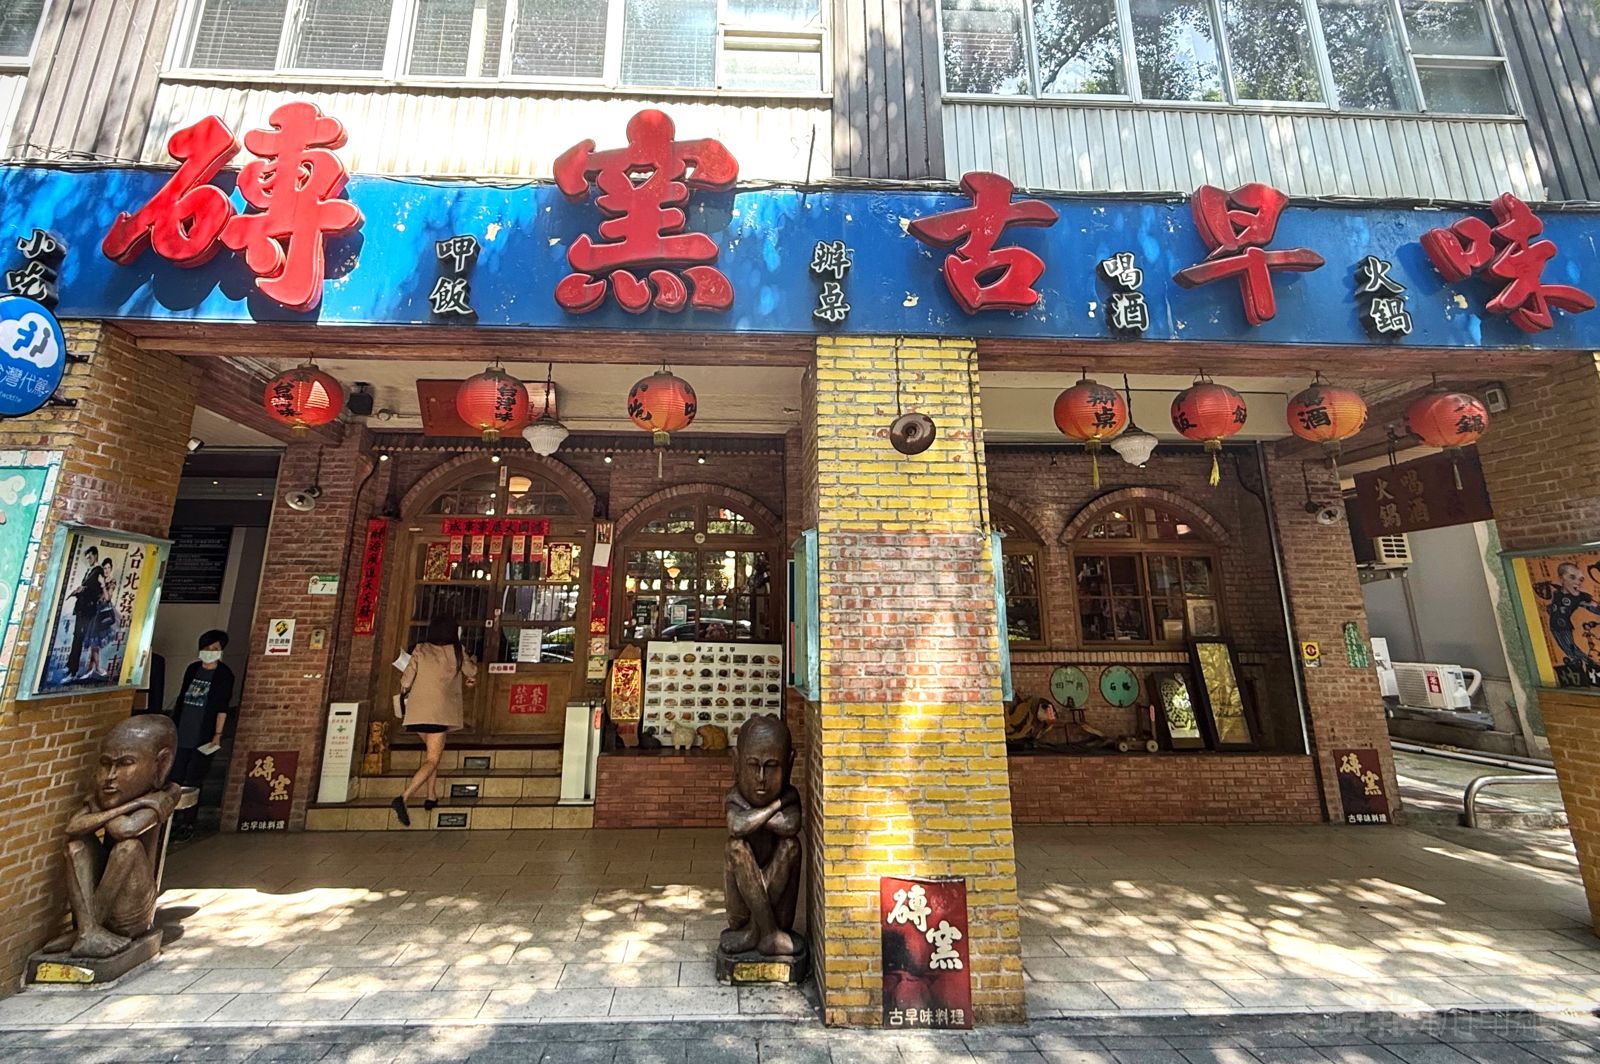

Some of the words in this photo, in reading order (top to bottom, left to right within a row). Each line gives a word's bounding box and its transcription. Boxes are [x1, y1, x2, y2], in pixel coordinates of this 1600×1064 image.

[7, 229, 57, 301] 小吃
[429, 235, 478, 316] 呷飯
[811, 240, 852, 321] 辦桌
[1104, 252, 1150, 331] 喝酒
[1364, 255, 1413, 335] 火鍋
[494, 383, 518, 422] 台灣味
[1087, 388, 1117, 429] 辦桌
[1374, 477, 1402, 529] 火鍋
[241, 820, 285, 831] 古早味料理
[1347, 813, 1387, 823] 古早味料理
[887, 884, 963, 970] 磚窯
[889, 1007, 965, 1026] 古早味料理
